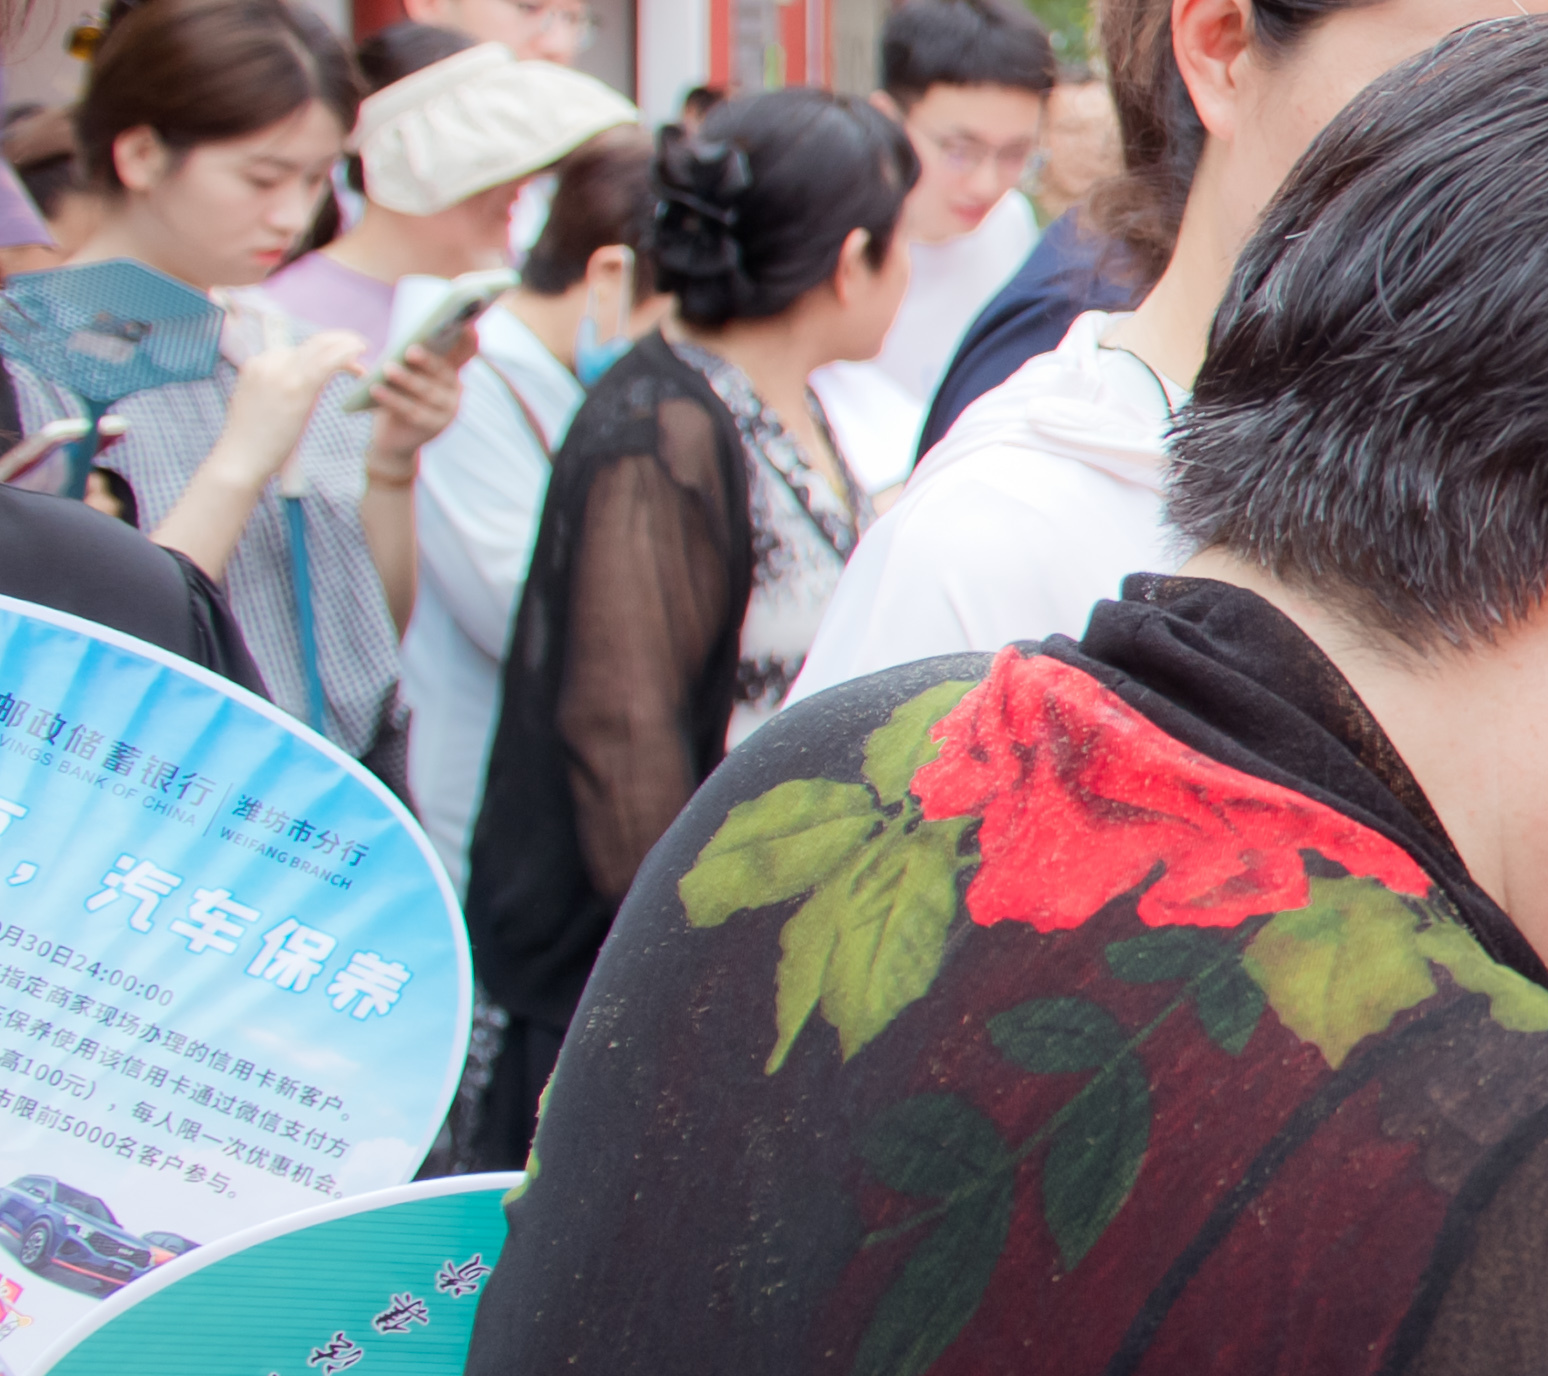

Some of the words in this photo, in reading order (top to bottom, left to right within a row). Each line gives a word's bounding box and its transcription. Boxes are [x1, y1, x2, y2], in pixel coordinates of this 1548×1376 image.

[57, 760, 109, 791] BANK
[111, 782, 138, 801] OF
[141, 794, 198, 828] CHINA
[231, 793, 370, 868] 潍坊市分行
[220, 826, 289, 865] WEIFANG
[289, 855, 354, 892] BRANCH
[0, 920, 174, 1008] 月30日24:00:00
[0, 960, 351, 1124] 指定商家现场办理的信用卡新客户。
